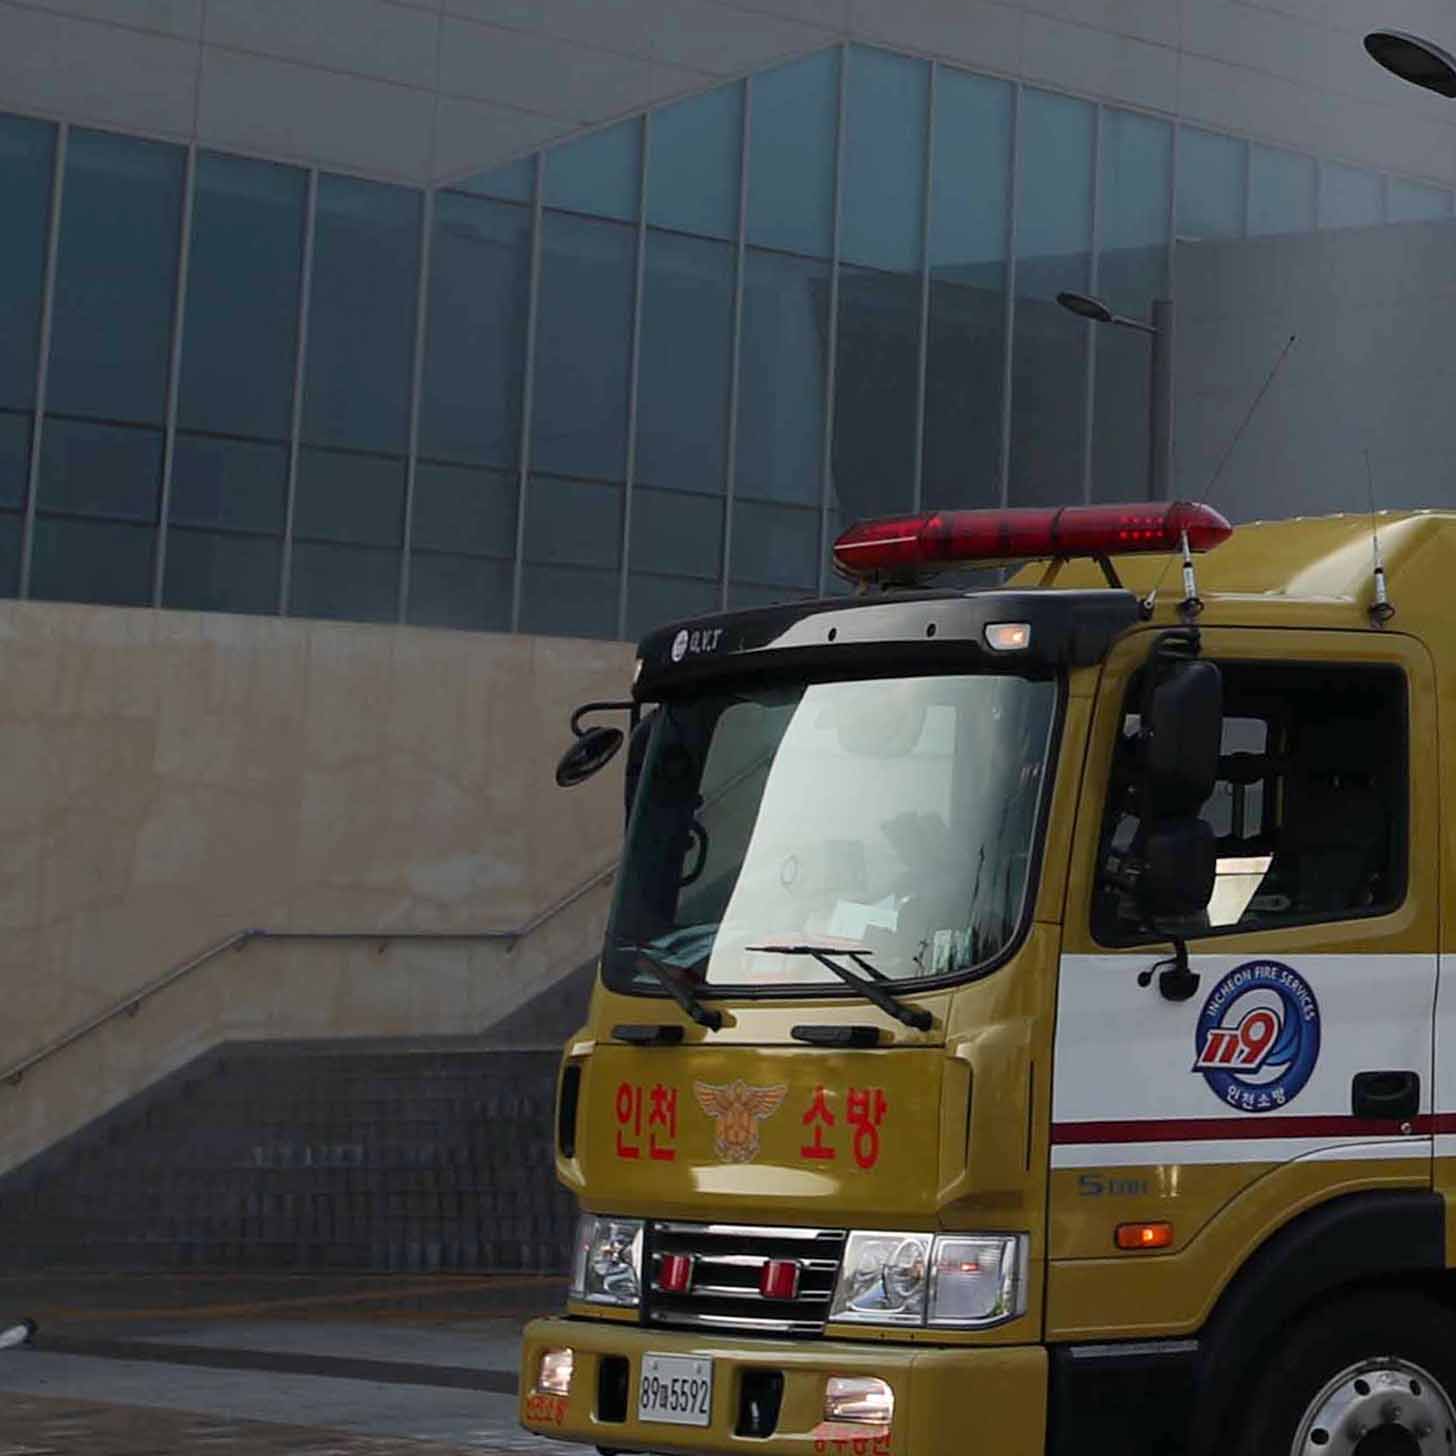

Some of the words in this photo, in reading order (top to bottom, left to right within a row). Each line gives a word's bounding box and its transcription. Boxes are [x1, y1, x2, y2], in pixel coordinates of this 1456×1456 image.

[1207, 968, 1252, 1017] INCHEON
[1254, 965, 1278, 981] FIRE
[1279, 969, 1317, 1021] SERVICES
[1199, 1009, 1277, 1065] 119
[615, 1081, 677, 1161] 인천
[800, 1083, 888, 1170] 소방
[1226, 1085, 1286, 1110] 인천소방
